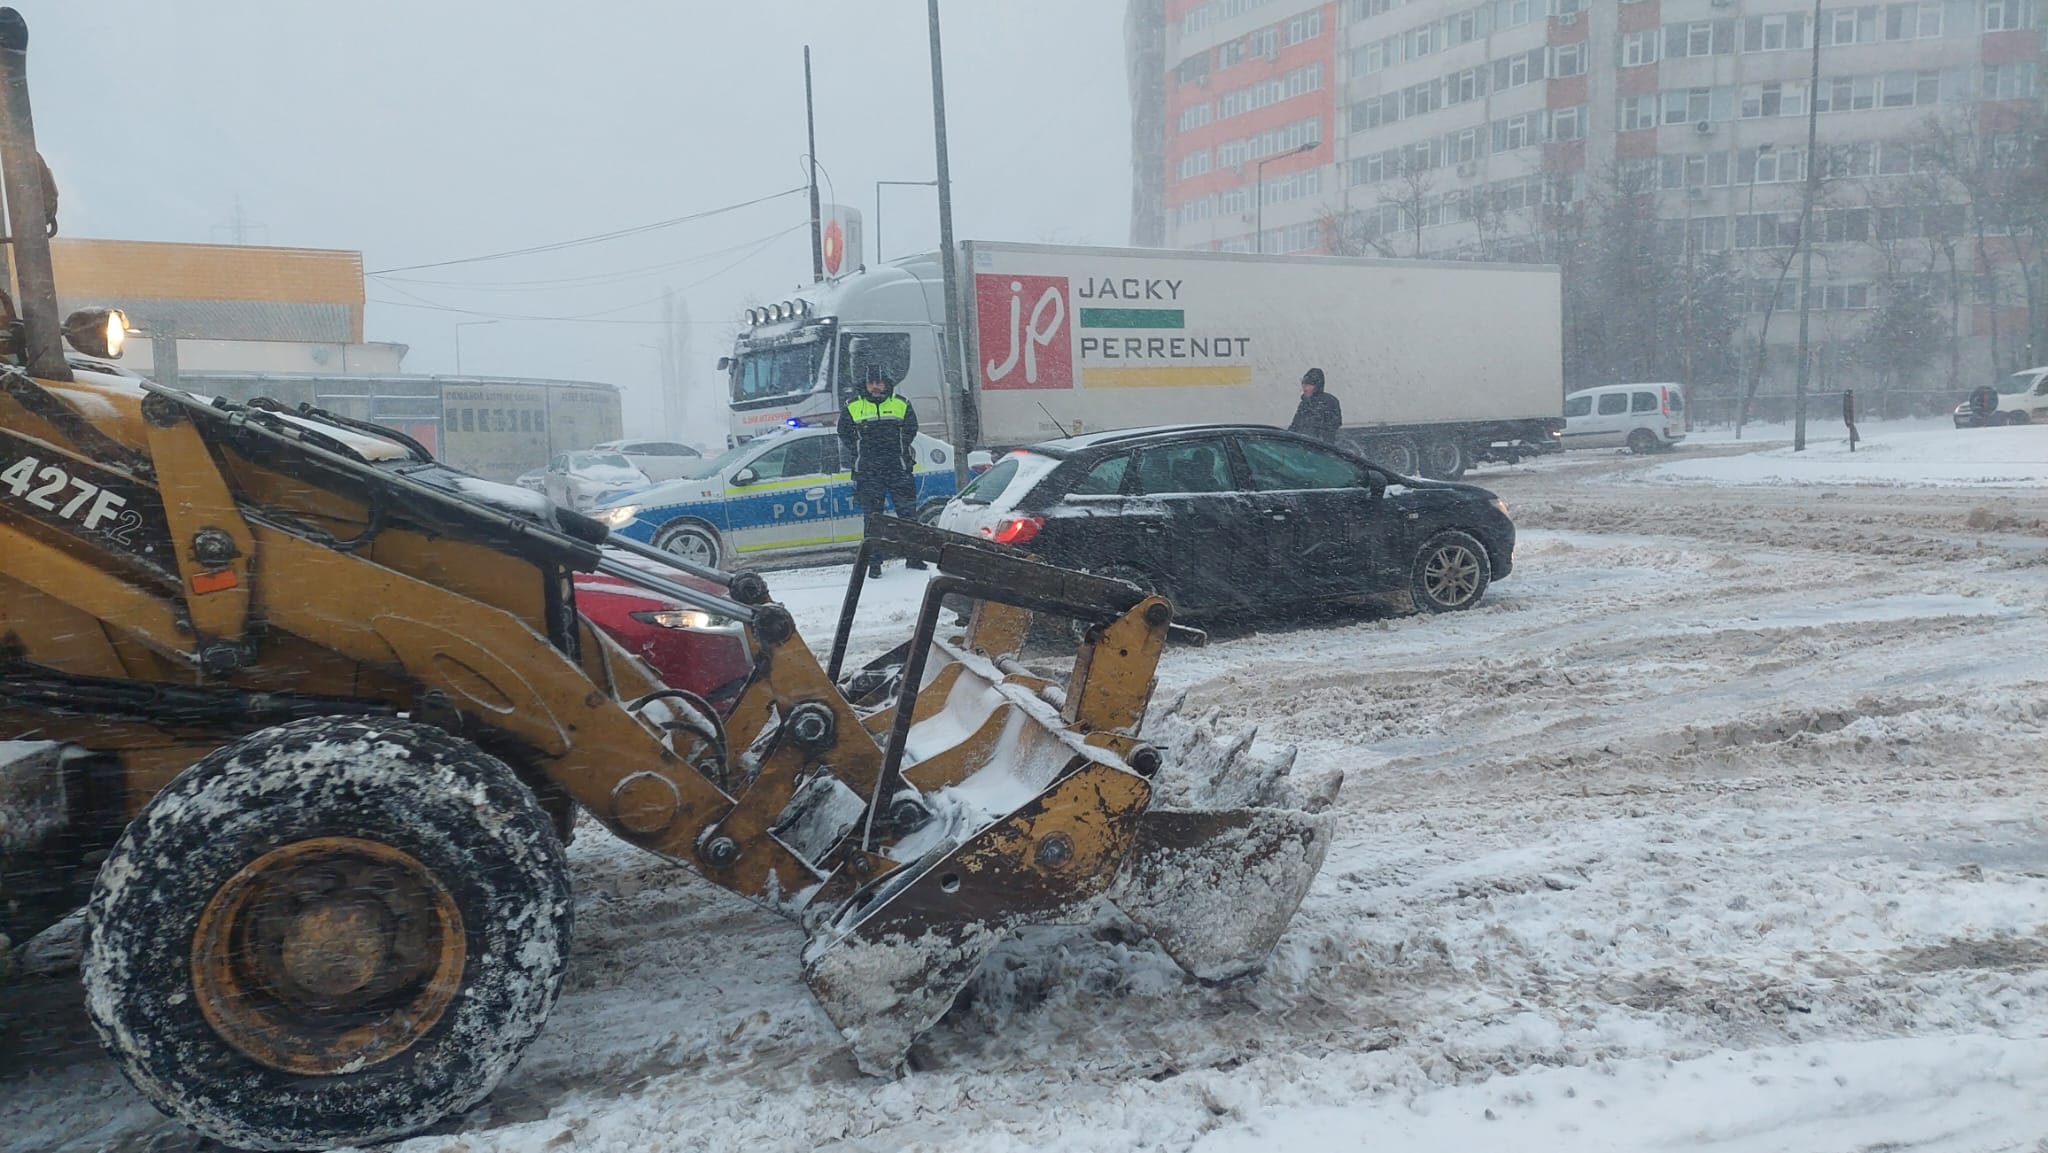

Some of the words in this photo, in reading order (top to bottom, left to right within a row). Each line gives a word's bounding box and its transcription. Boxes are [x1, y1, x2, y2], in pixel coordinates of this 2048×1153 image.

[1078, 277, 1183, 300] JACKY
[1081, 337, 1251, 358] PERRENOT
[773, 496, 890, 518] POLIT
